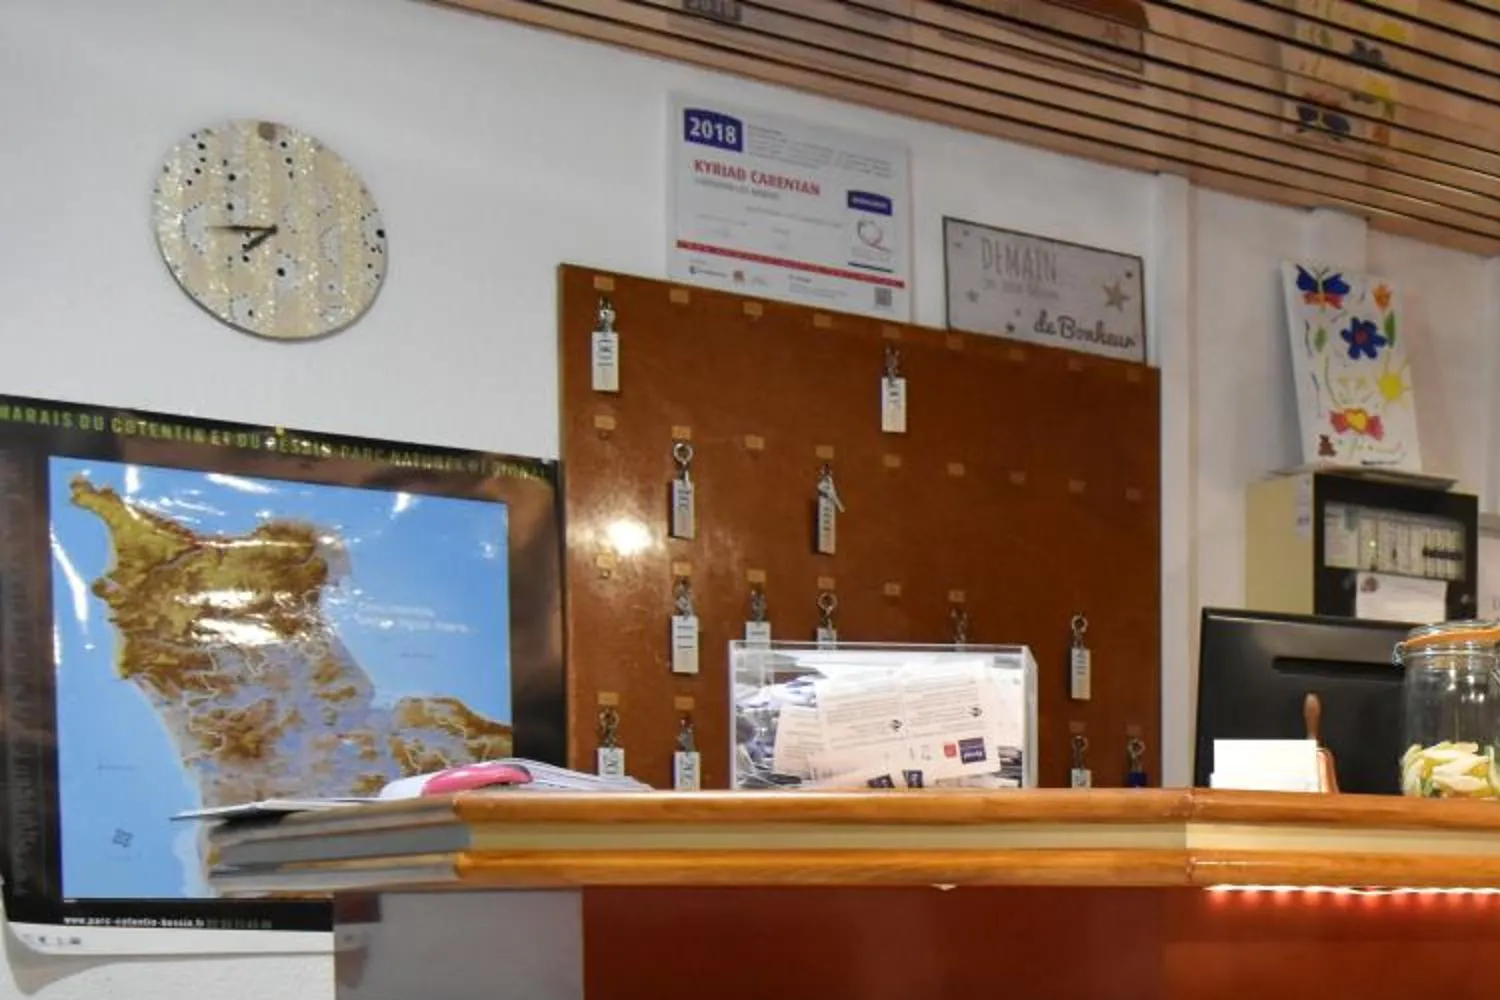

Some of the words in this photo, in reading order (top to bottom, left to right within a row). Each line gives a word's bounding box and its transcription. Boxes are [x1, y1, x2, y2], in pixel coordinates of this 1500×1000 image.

[690, 117, 738, 145] 2018
[694, 159, 746, 182] KYRIAD
[751, 169, 821, 196] CARENTAN
[980, 237, 1058, 283] DEMAIN
[1057, 315, 1137, 349] Bonheur
[79, 413, 105, 431] DU
[111, 416, 204, 443] COTENTIN
[238, 432, 261, 449] DU
